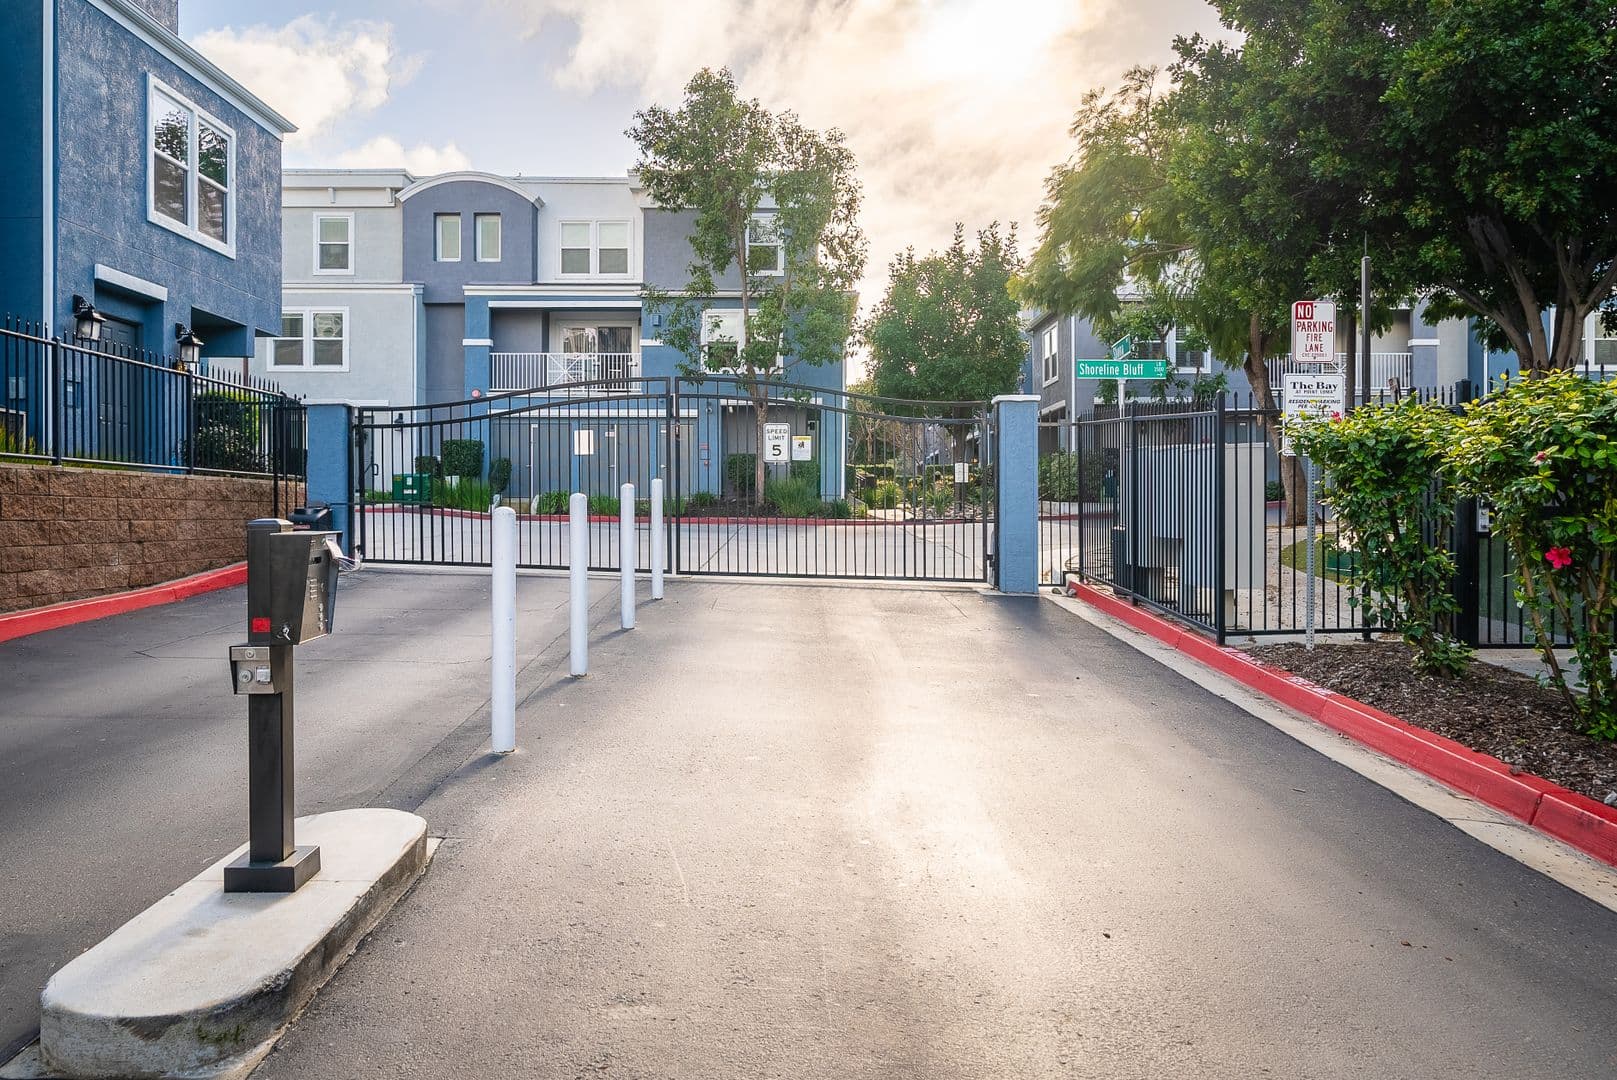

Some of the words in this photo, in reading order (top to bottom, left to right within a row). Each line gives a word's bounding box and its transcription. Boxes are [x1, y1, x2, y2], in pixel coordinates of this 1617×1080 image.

[1297, 304, 1312, 318] NO
[1296, 321, 1333, 332] PARKING
[1306, 333, 1323, 342] FIRE
[1305, 343, 1324, 352] LANE
[1079, 362, 1119, 375] Shoreline
[1123, 363, 1144, 375] Bluff
[1290, 381, 1313, 390] The
[1316, 381, 1338, 391] Bay
[772, 444, 782, 456] 5
